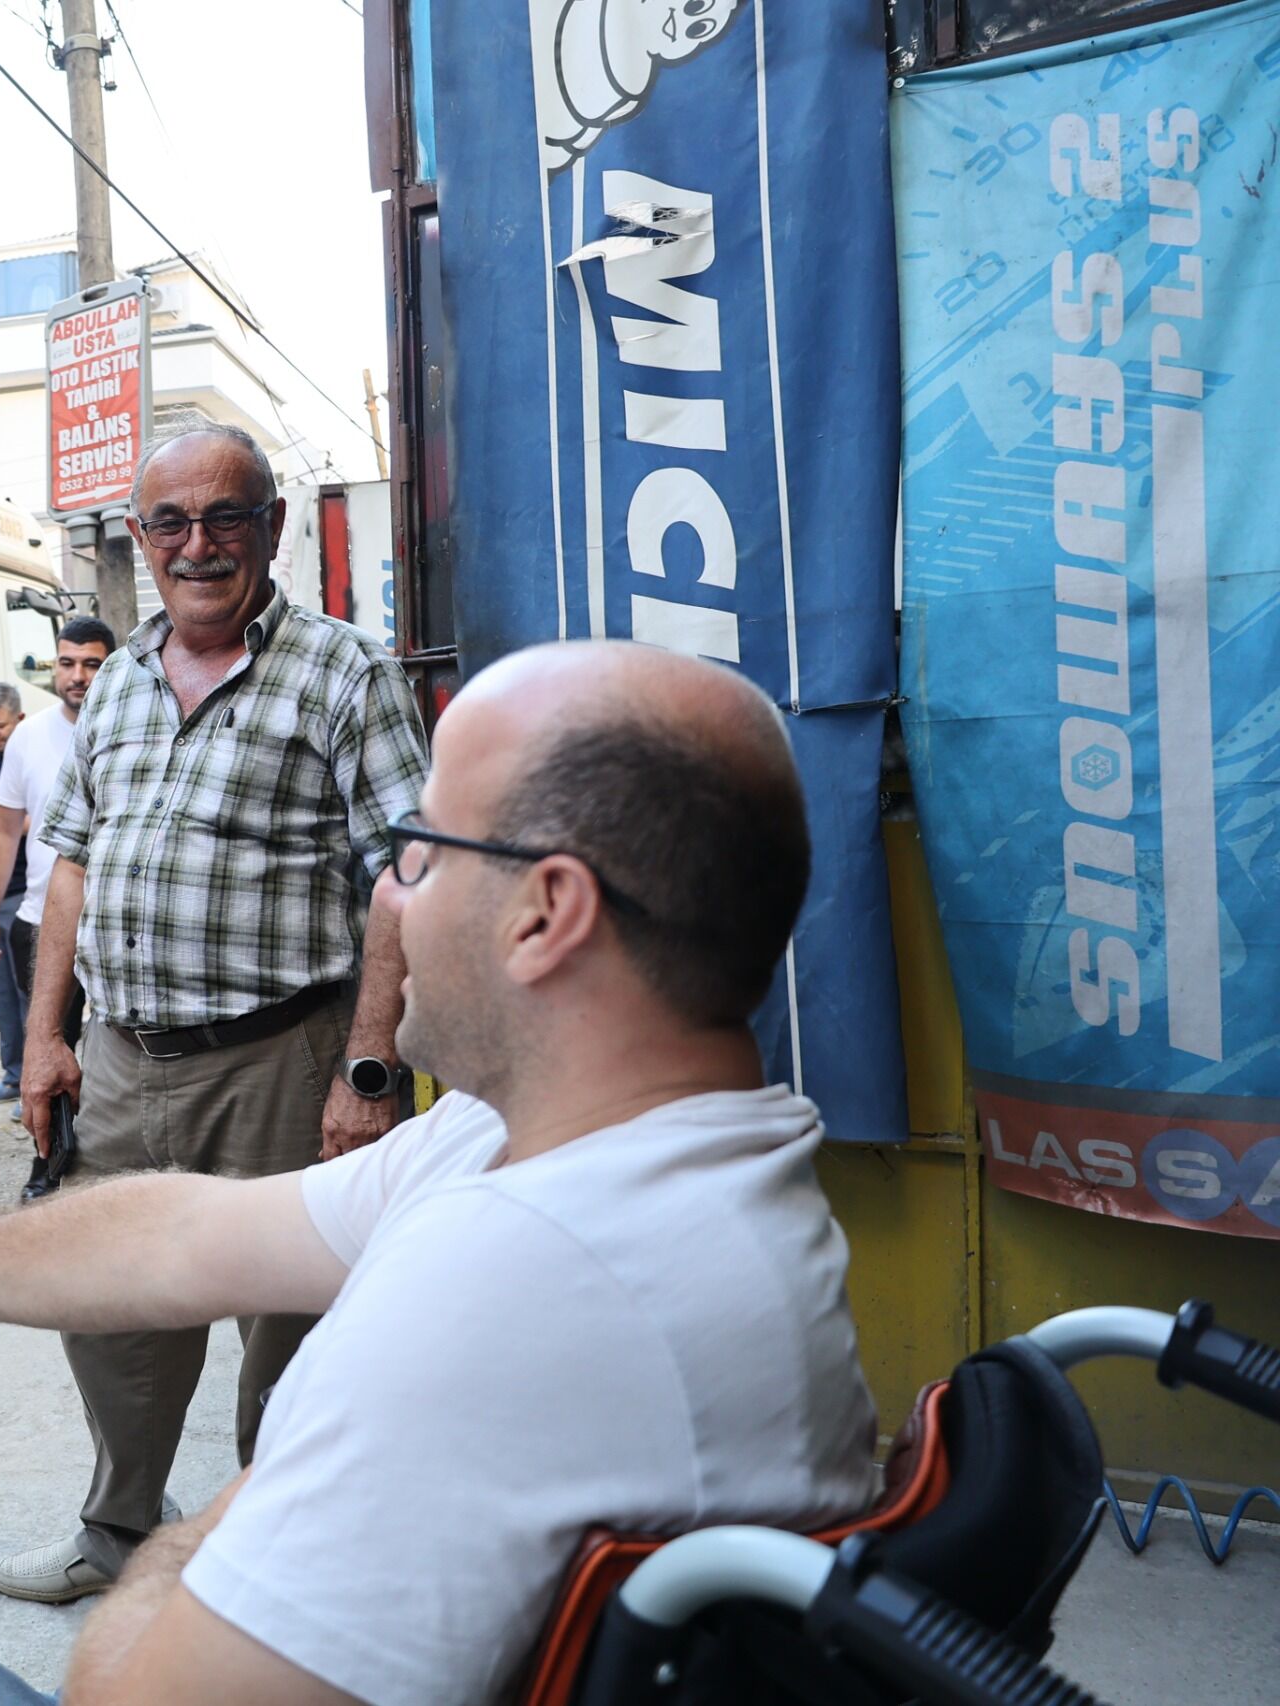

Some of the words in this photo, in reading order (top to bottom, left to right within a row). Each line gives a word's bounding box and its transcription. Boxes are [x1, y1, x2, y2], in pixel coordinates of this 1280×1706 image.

[1049, 112, 1122, 200] 2
[1146, 106, 1204, 400] PLUS
[52, 297, 139, 343] ABDULLAH
[73, 328, 116, 357] USTA
[51, 366, 80, 392] OTO
[82, 349, 139, 382] LASTİK
[65, 373, 121, 410] TAMİRİ
[58, 412, 131, 452] BALANS
[87, 404, 100, 421] &
[58, 435, 133, 478] SERVİSİ
[59, 478, 83, 493] 0532
